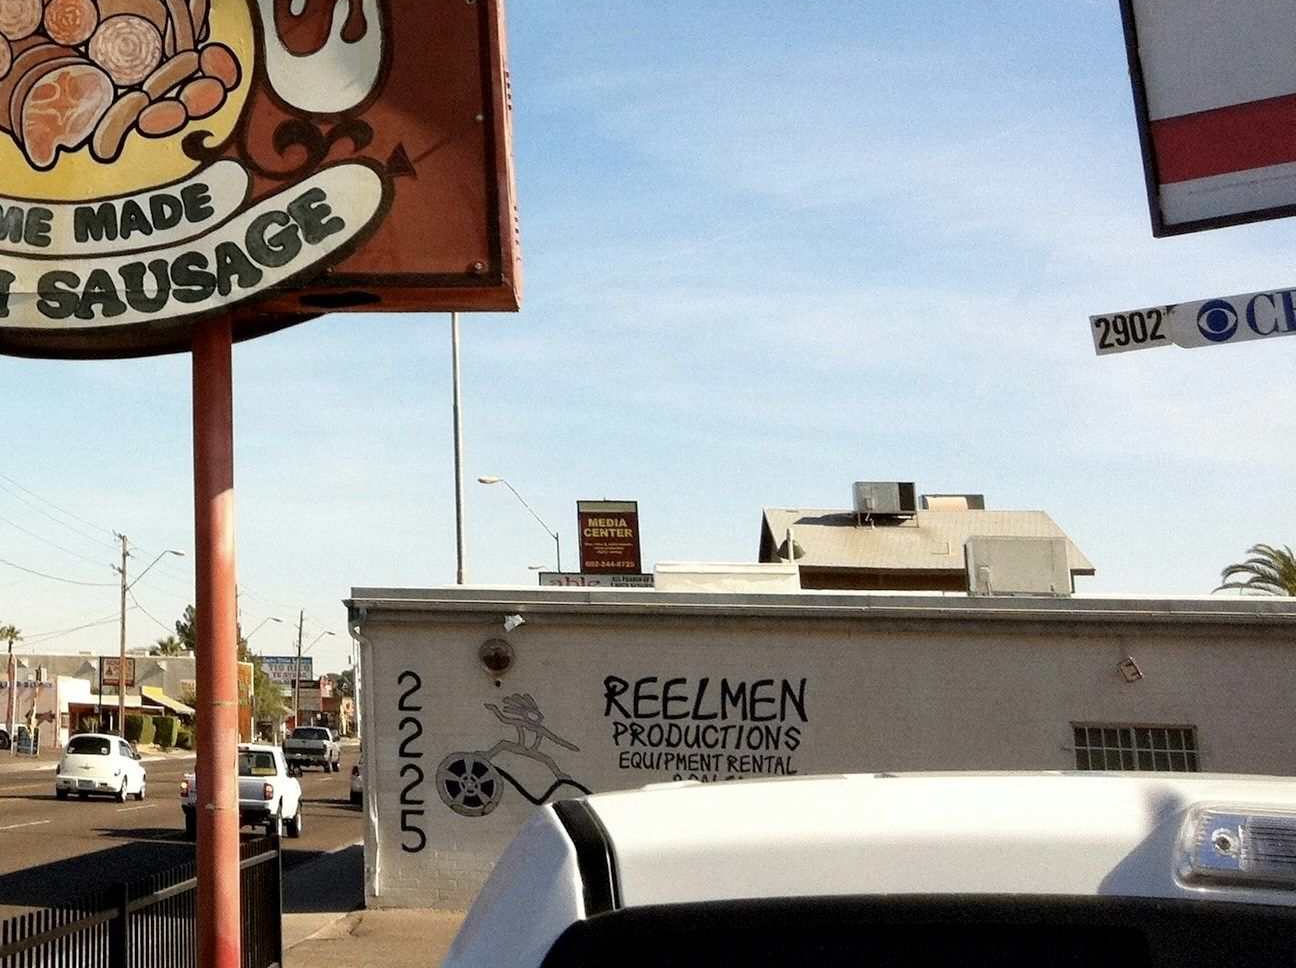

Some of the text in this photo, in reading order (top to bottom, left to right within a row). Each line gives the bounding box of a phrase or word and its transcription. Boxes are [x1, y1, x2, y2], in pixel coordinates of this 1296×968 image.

[72, 182, 215, 244] MADE
[35, 186, 345, 320] SAUSAGE
[1094, 308, 1166, 349] 2902
[584, 528, 632, 538] CENTER
[588, 518, 627, 527] MEDIA
[604, 675, 808, 722] REELMEN
[612, 722, 801, 752] PRODUCTIONS
[619, 751, 798, 776] EQUIPMENT RENTAL
